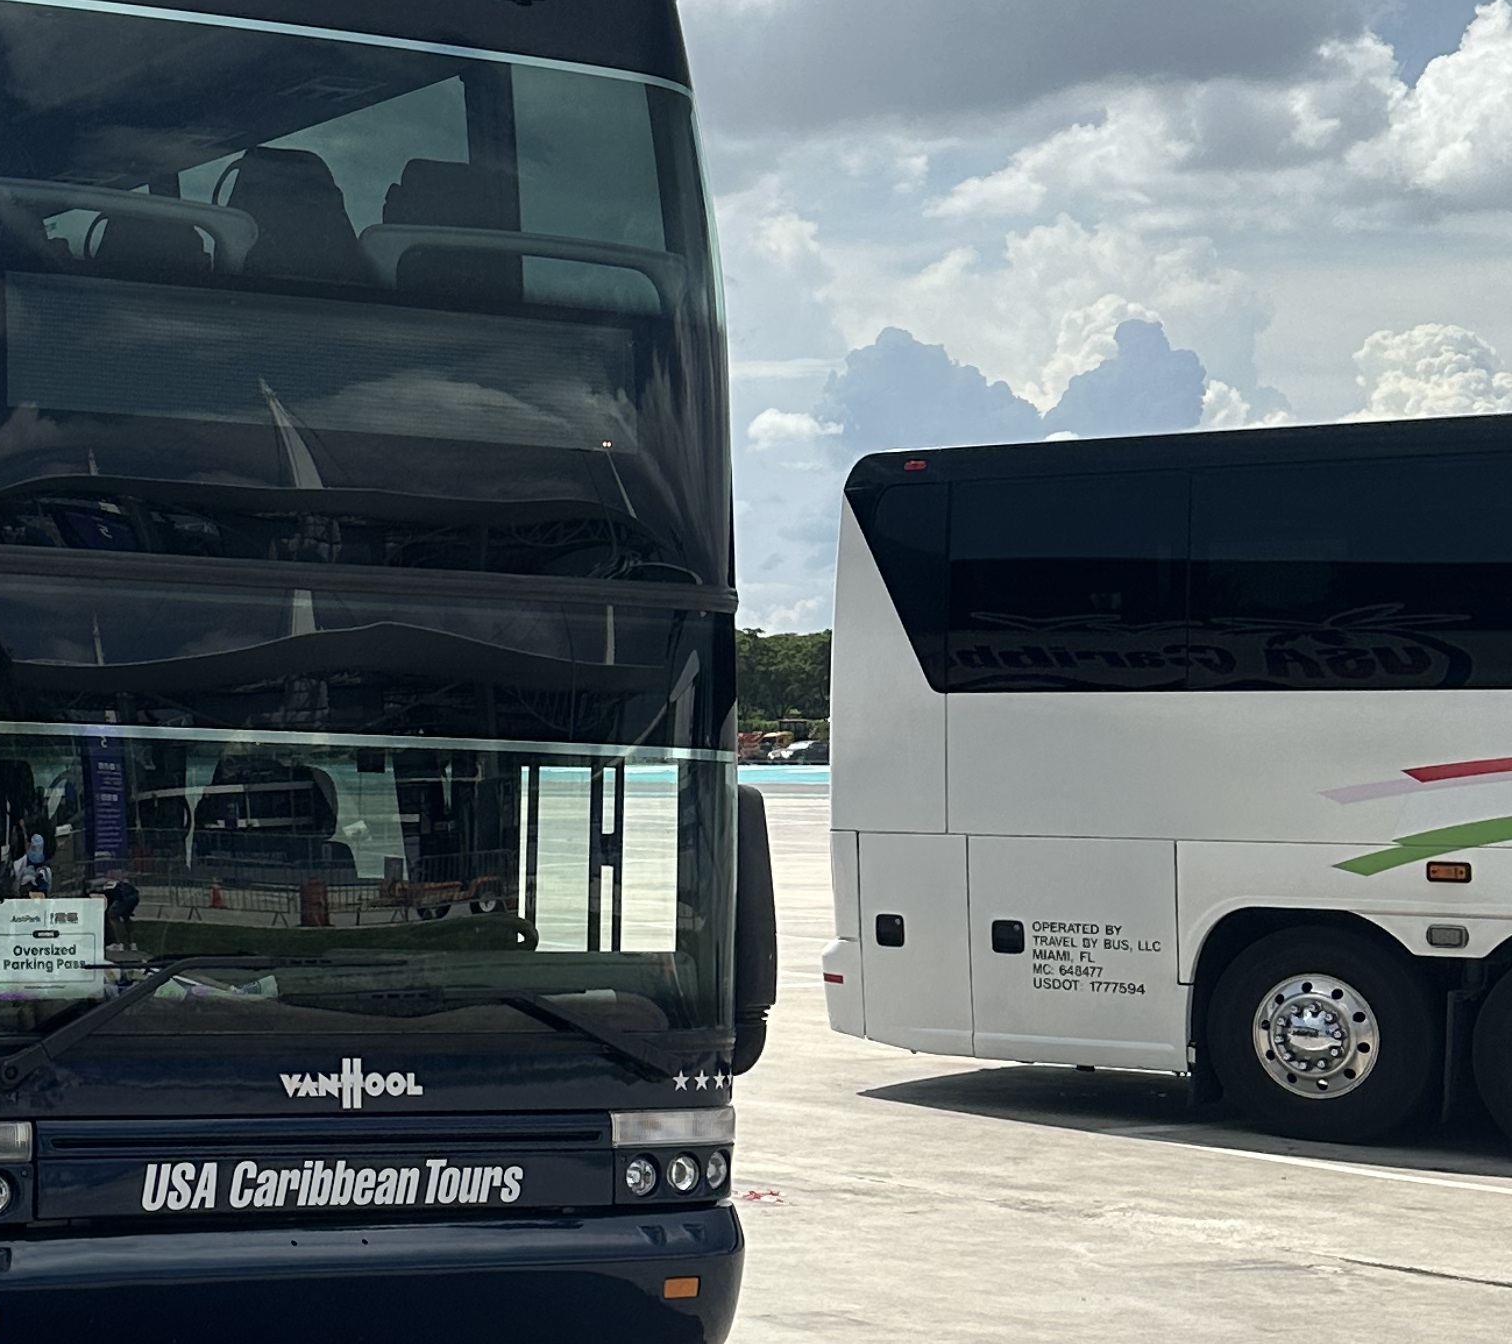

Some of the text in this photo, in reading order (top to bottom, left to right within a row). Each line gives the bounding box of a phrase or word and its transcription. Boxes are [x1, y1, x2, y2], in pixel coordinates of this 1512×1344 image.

[1031, 920, 1123, 936] OPERATED BY
[13, 944, 77, 956] Oversized
[1032, 935, 1078, 948] TRAVEL
[1103, 938, 1133, 953] BUS,
[1137, 940, 1161, 953] LLC
[1032, 948, 1096, 963] MIAMI, FL
[3, 958, 86, 972] Parking Pass
[1089, 981, 1146, 995] 1777594
[141, 1159, 523, 1212] USA Caribbean Tours
